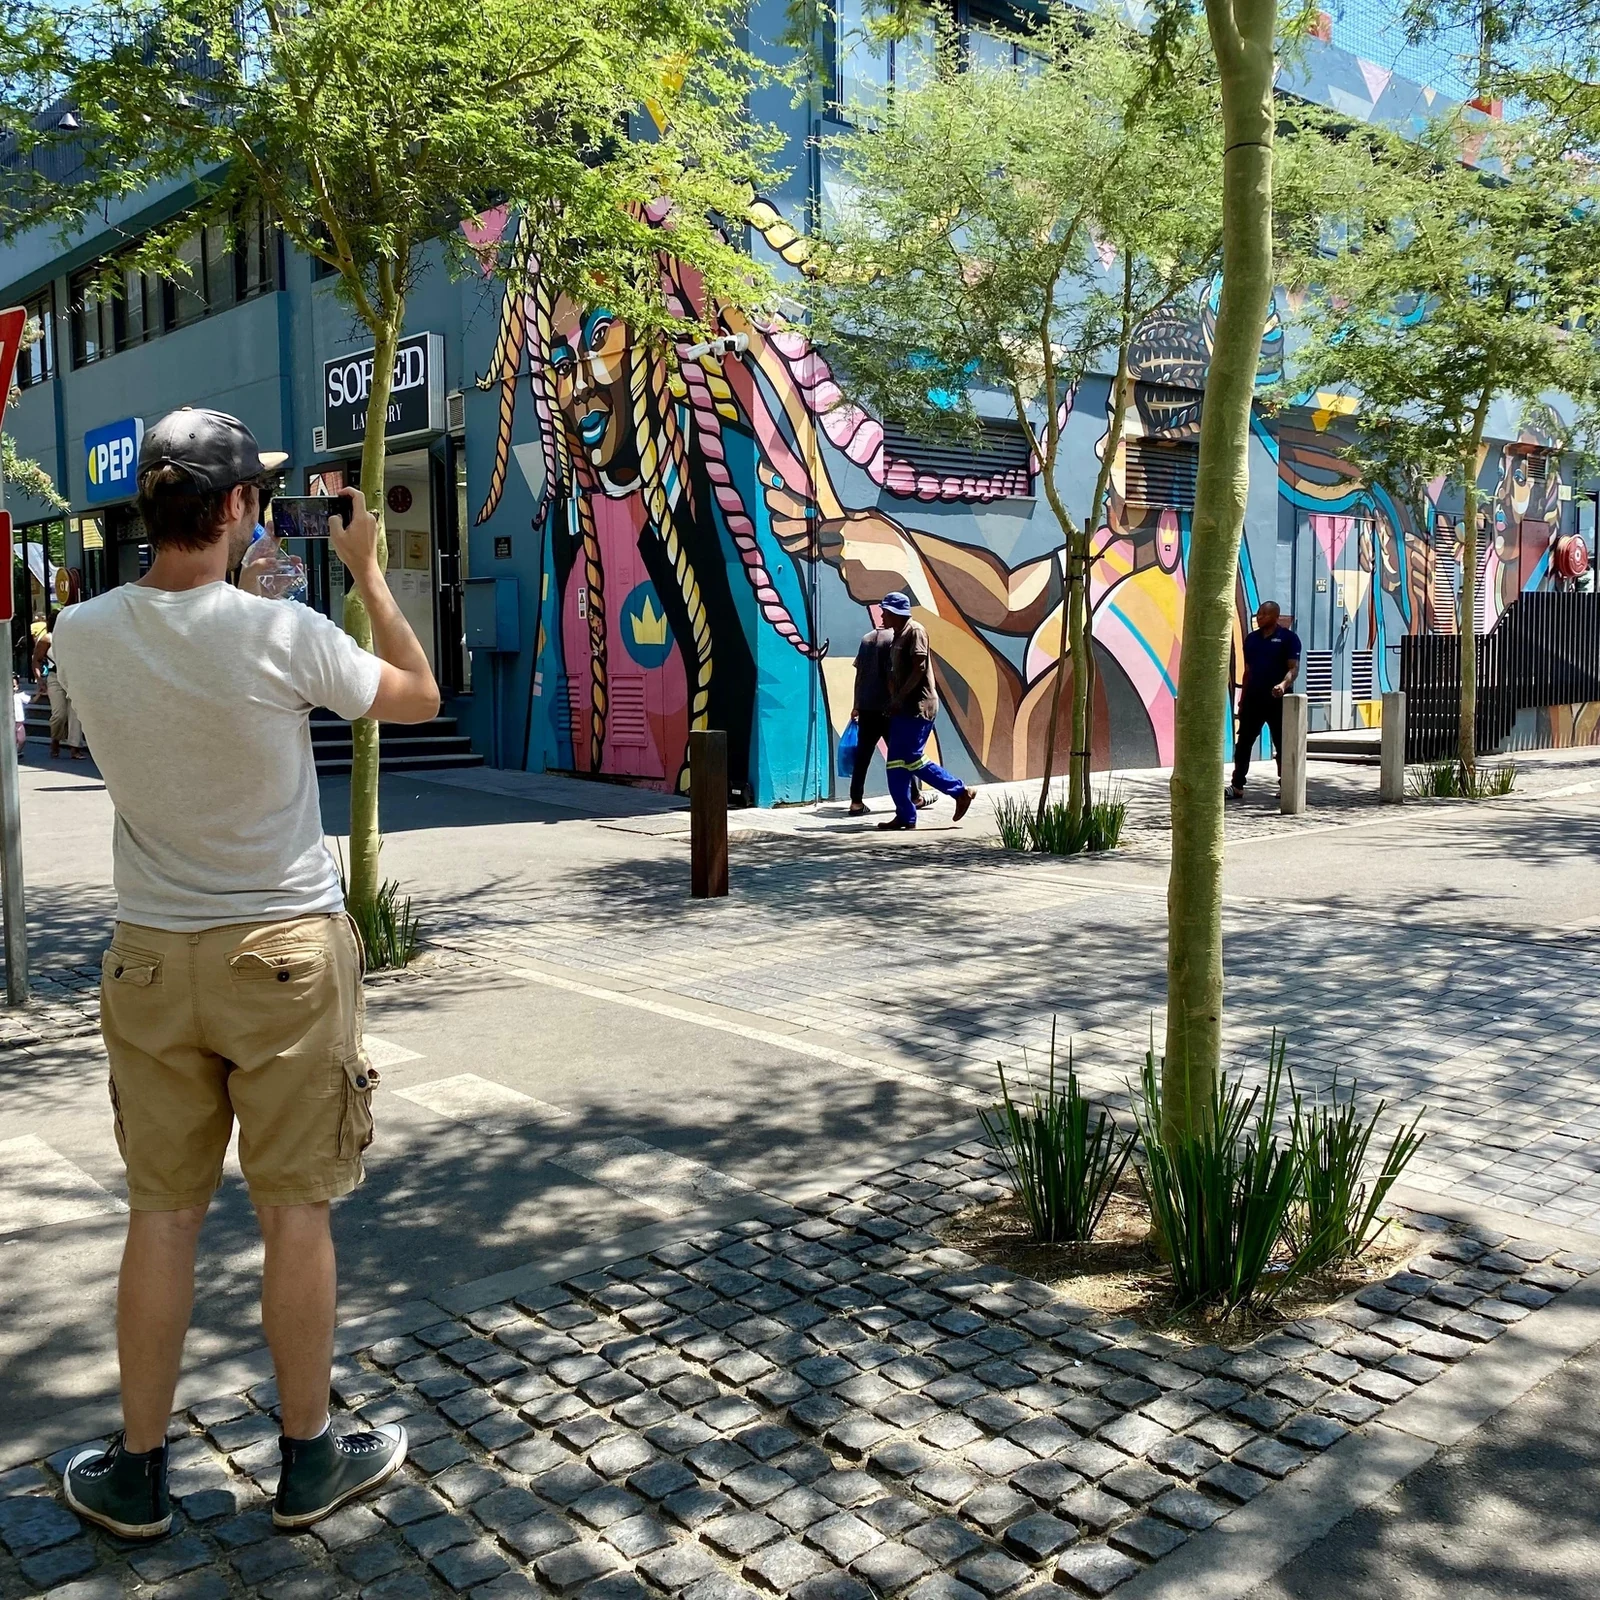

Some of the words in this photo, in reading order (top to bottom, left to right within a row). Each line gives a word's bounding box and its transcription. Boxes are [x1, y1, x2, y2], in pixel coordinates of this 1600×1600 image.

[328, 346, 425, 408] SORED.
[352, 403, 403, 431] LARY
[97, 436, 134, 484] PEP
